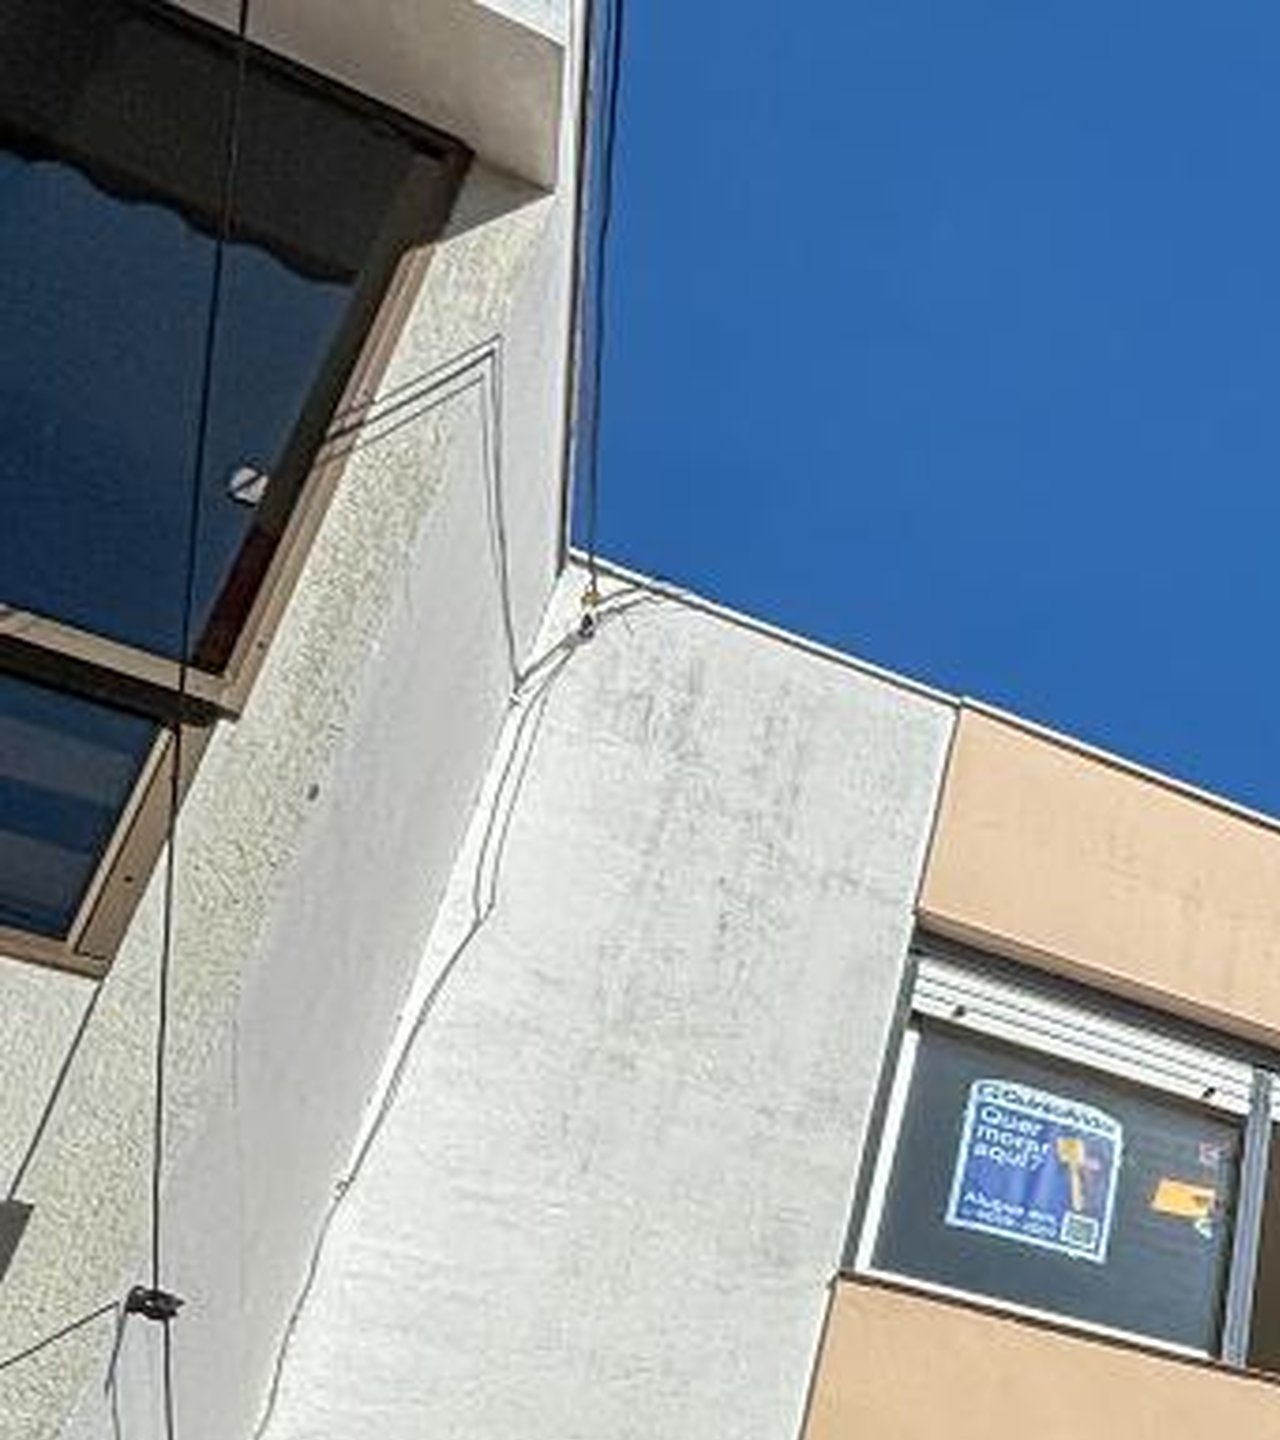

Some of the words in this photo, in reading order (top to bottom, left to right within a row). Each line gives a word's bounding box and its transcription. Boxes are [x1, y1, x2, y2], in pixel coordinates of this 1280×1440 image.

[981, 1105, 1044, 1137] Quer
[975, 1124, 1051, 1156] morar
[973, 1141, 1045, 1172] aqui?
